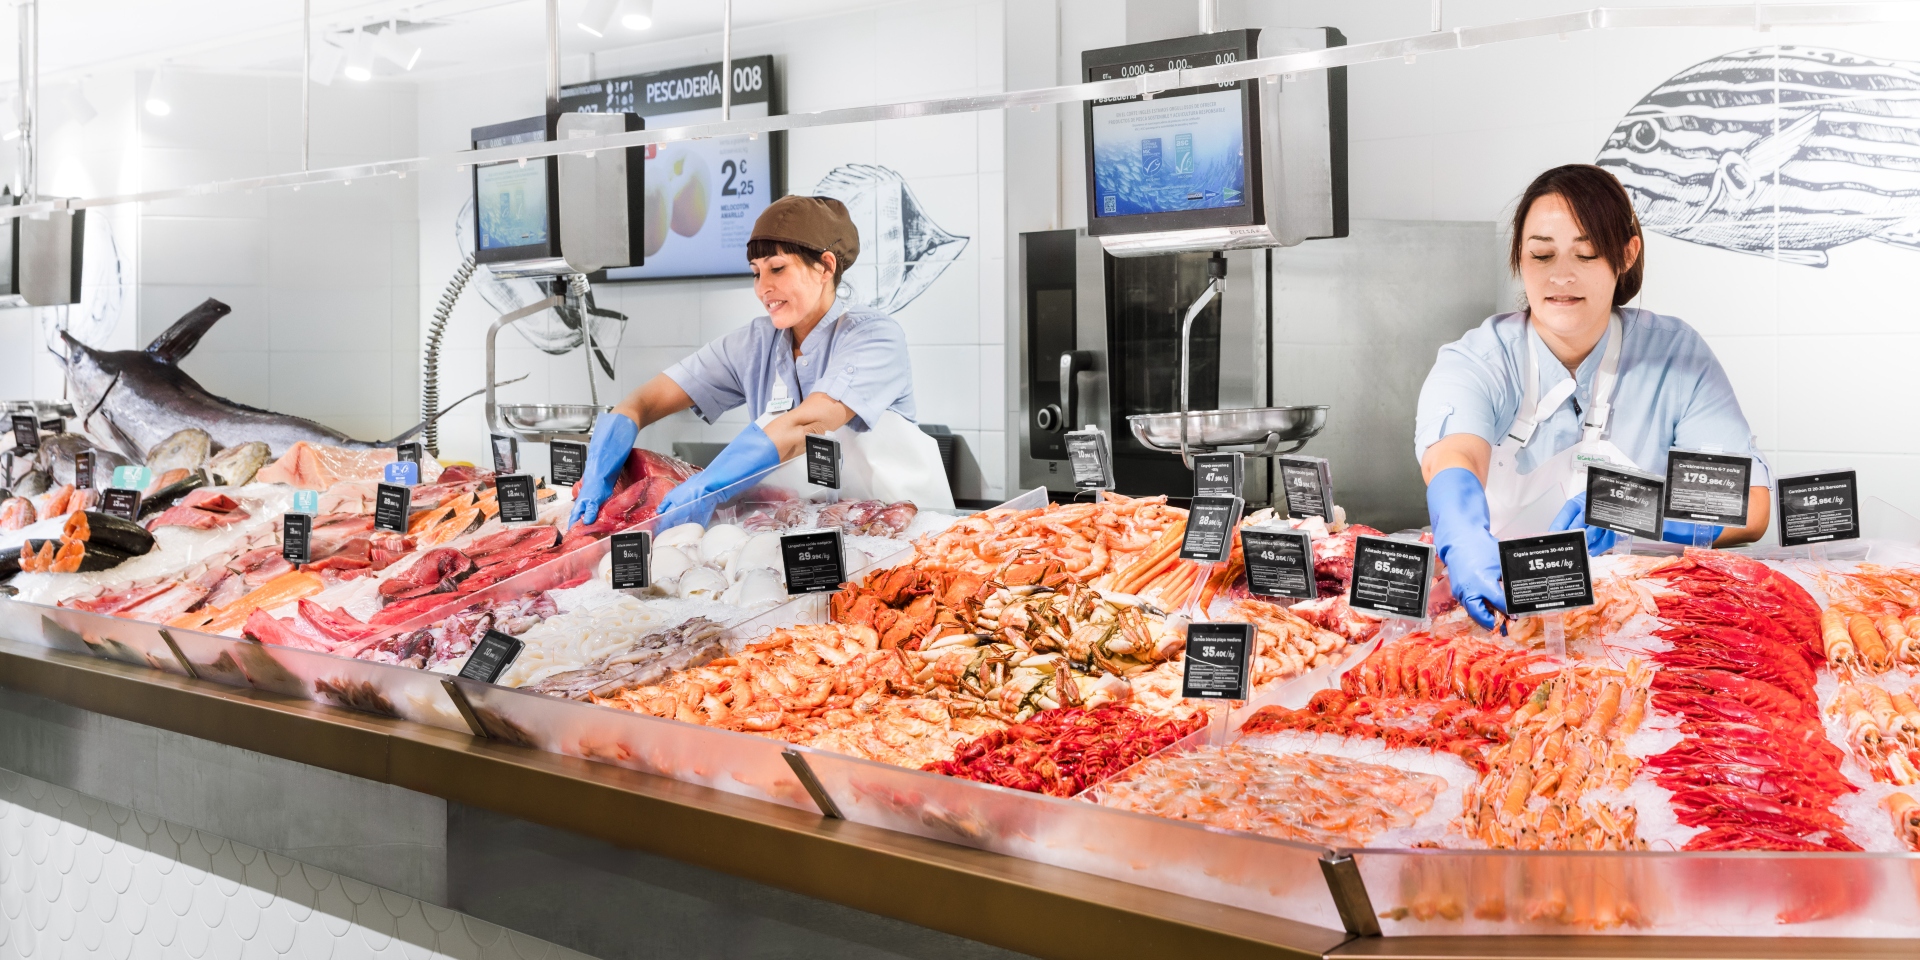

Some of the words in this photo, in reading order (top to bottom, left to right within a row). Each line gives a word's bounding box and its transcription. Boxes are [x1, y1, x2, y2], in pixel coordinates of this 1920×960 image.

[646, 70, 722, 104] PESCADERÍA
[733, 65, 762, 93] 008
[722, 160, 737, 196] 2
[740, 160, 747, 174] €
[721, 203, 749, 211] MELOCOTÓN
